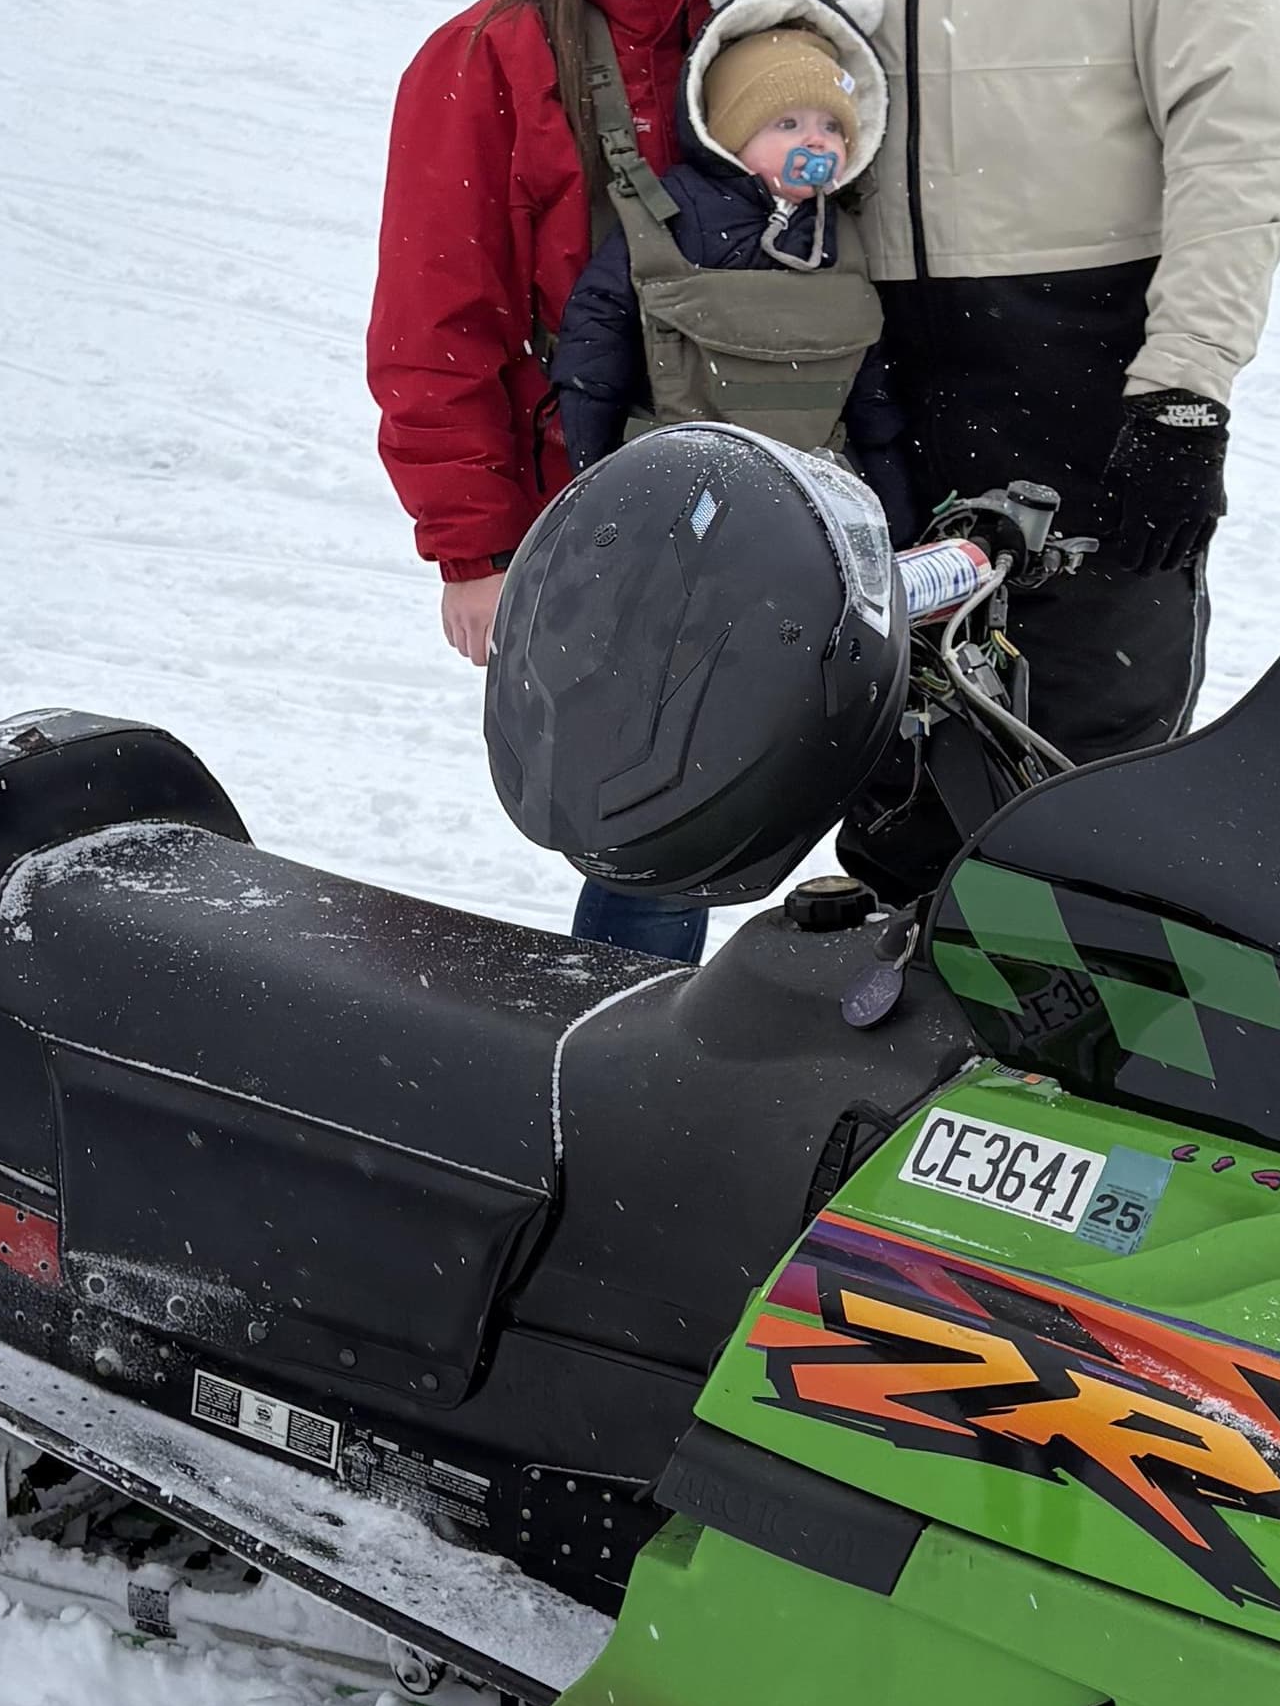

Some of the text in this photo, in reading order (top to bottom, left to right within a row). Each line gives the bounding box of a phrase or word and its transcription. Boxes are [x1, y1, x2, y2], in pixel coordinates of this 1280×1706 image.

[1165, 403, 1213, 416] TEAM
[912, 1117, 1092, 1223] CE3641
[1087, 1193, 1145, 1233] 25
